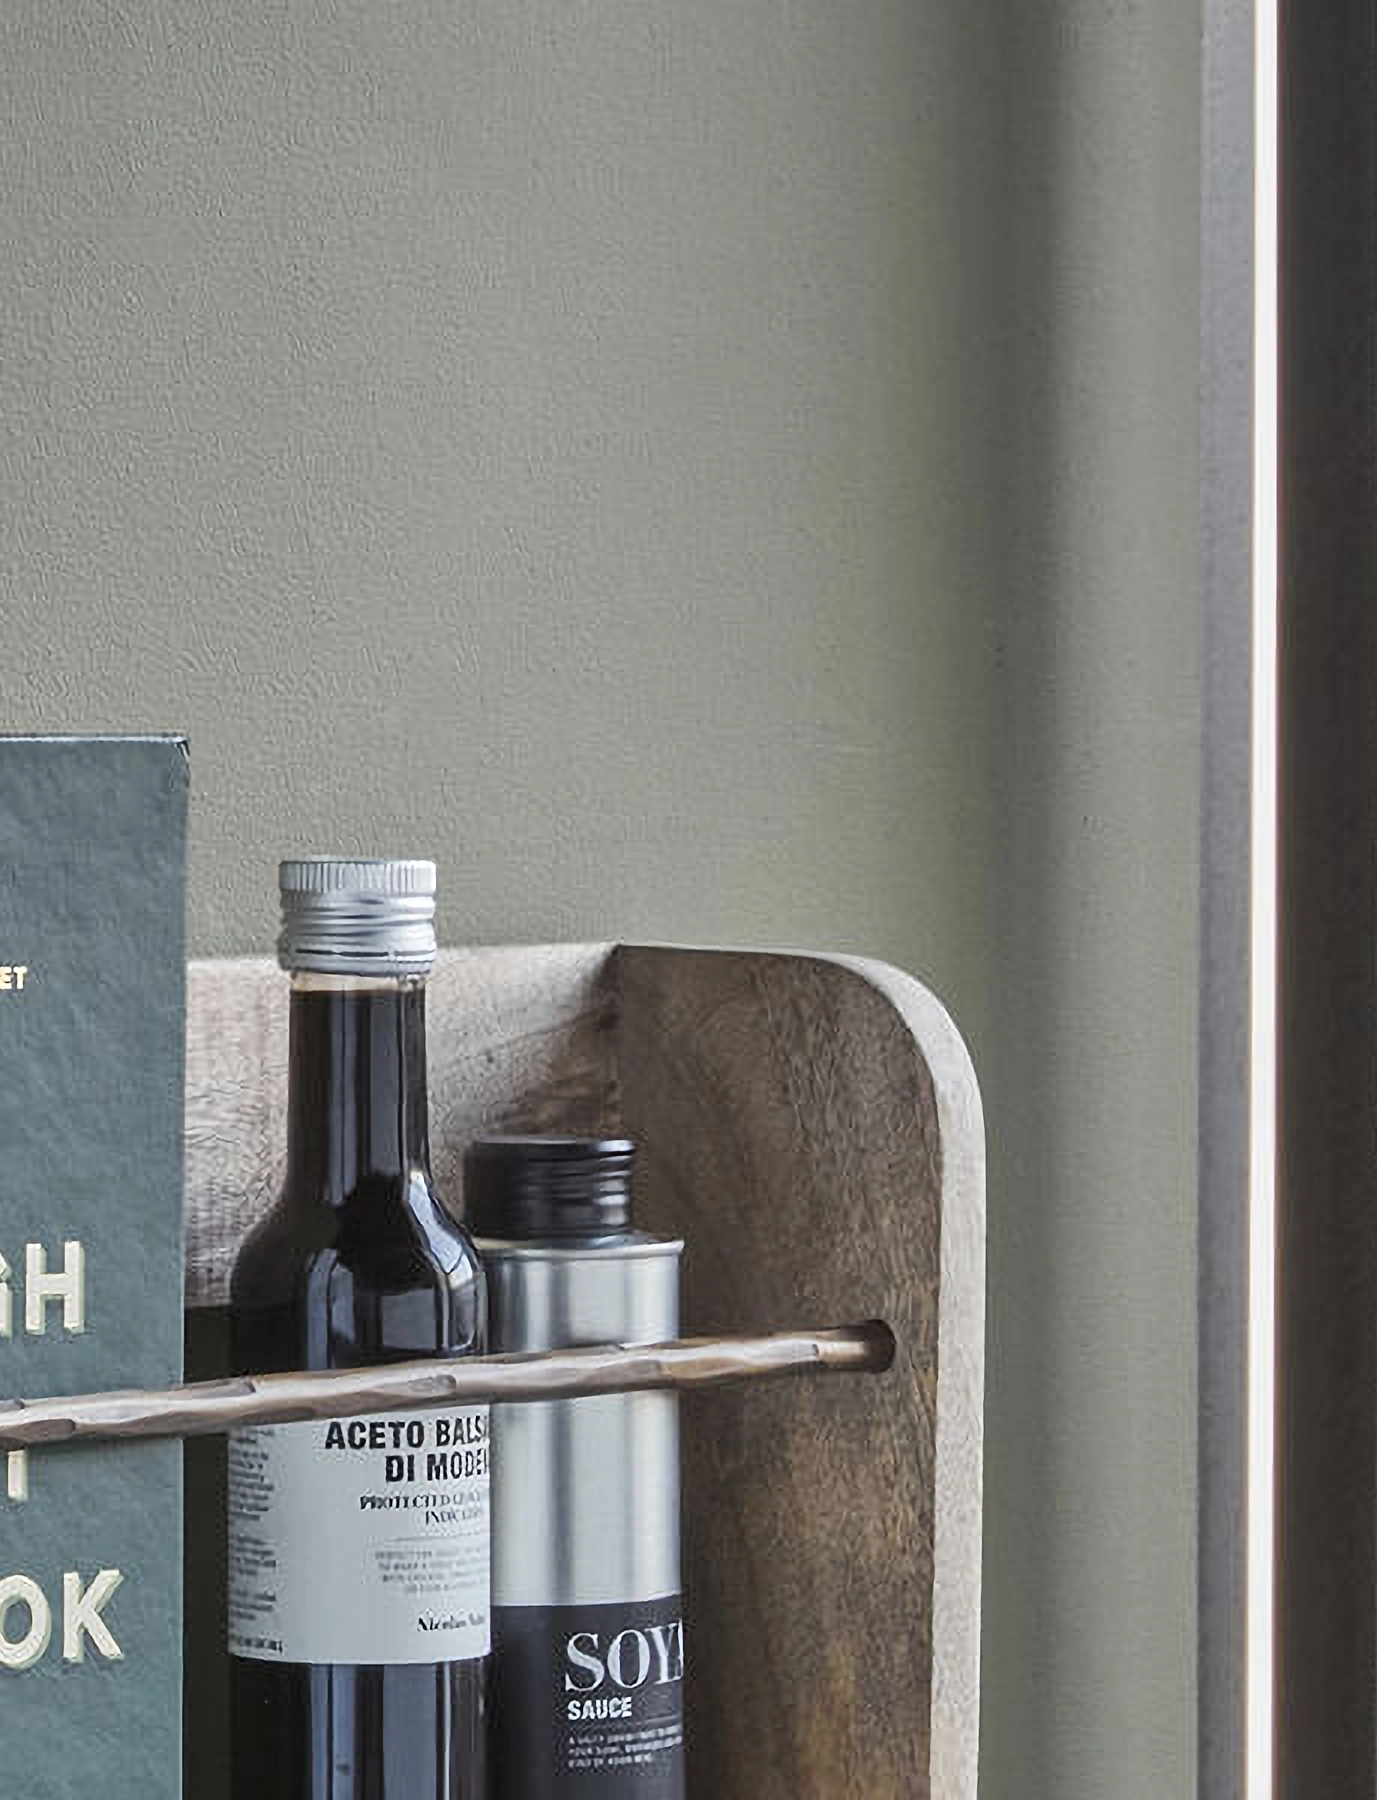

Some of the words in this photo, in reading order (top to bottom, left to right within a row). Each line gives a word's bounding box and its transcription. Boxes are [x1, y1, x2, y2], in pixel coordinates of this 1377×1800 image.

[324, 1420, 424, 1449] ACETO
[436, 1415, 487, 1448] BALS
[385, 1454, 415, 1482] DI
[567, 1696, 632, 1720] SAUCE
